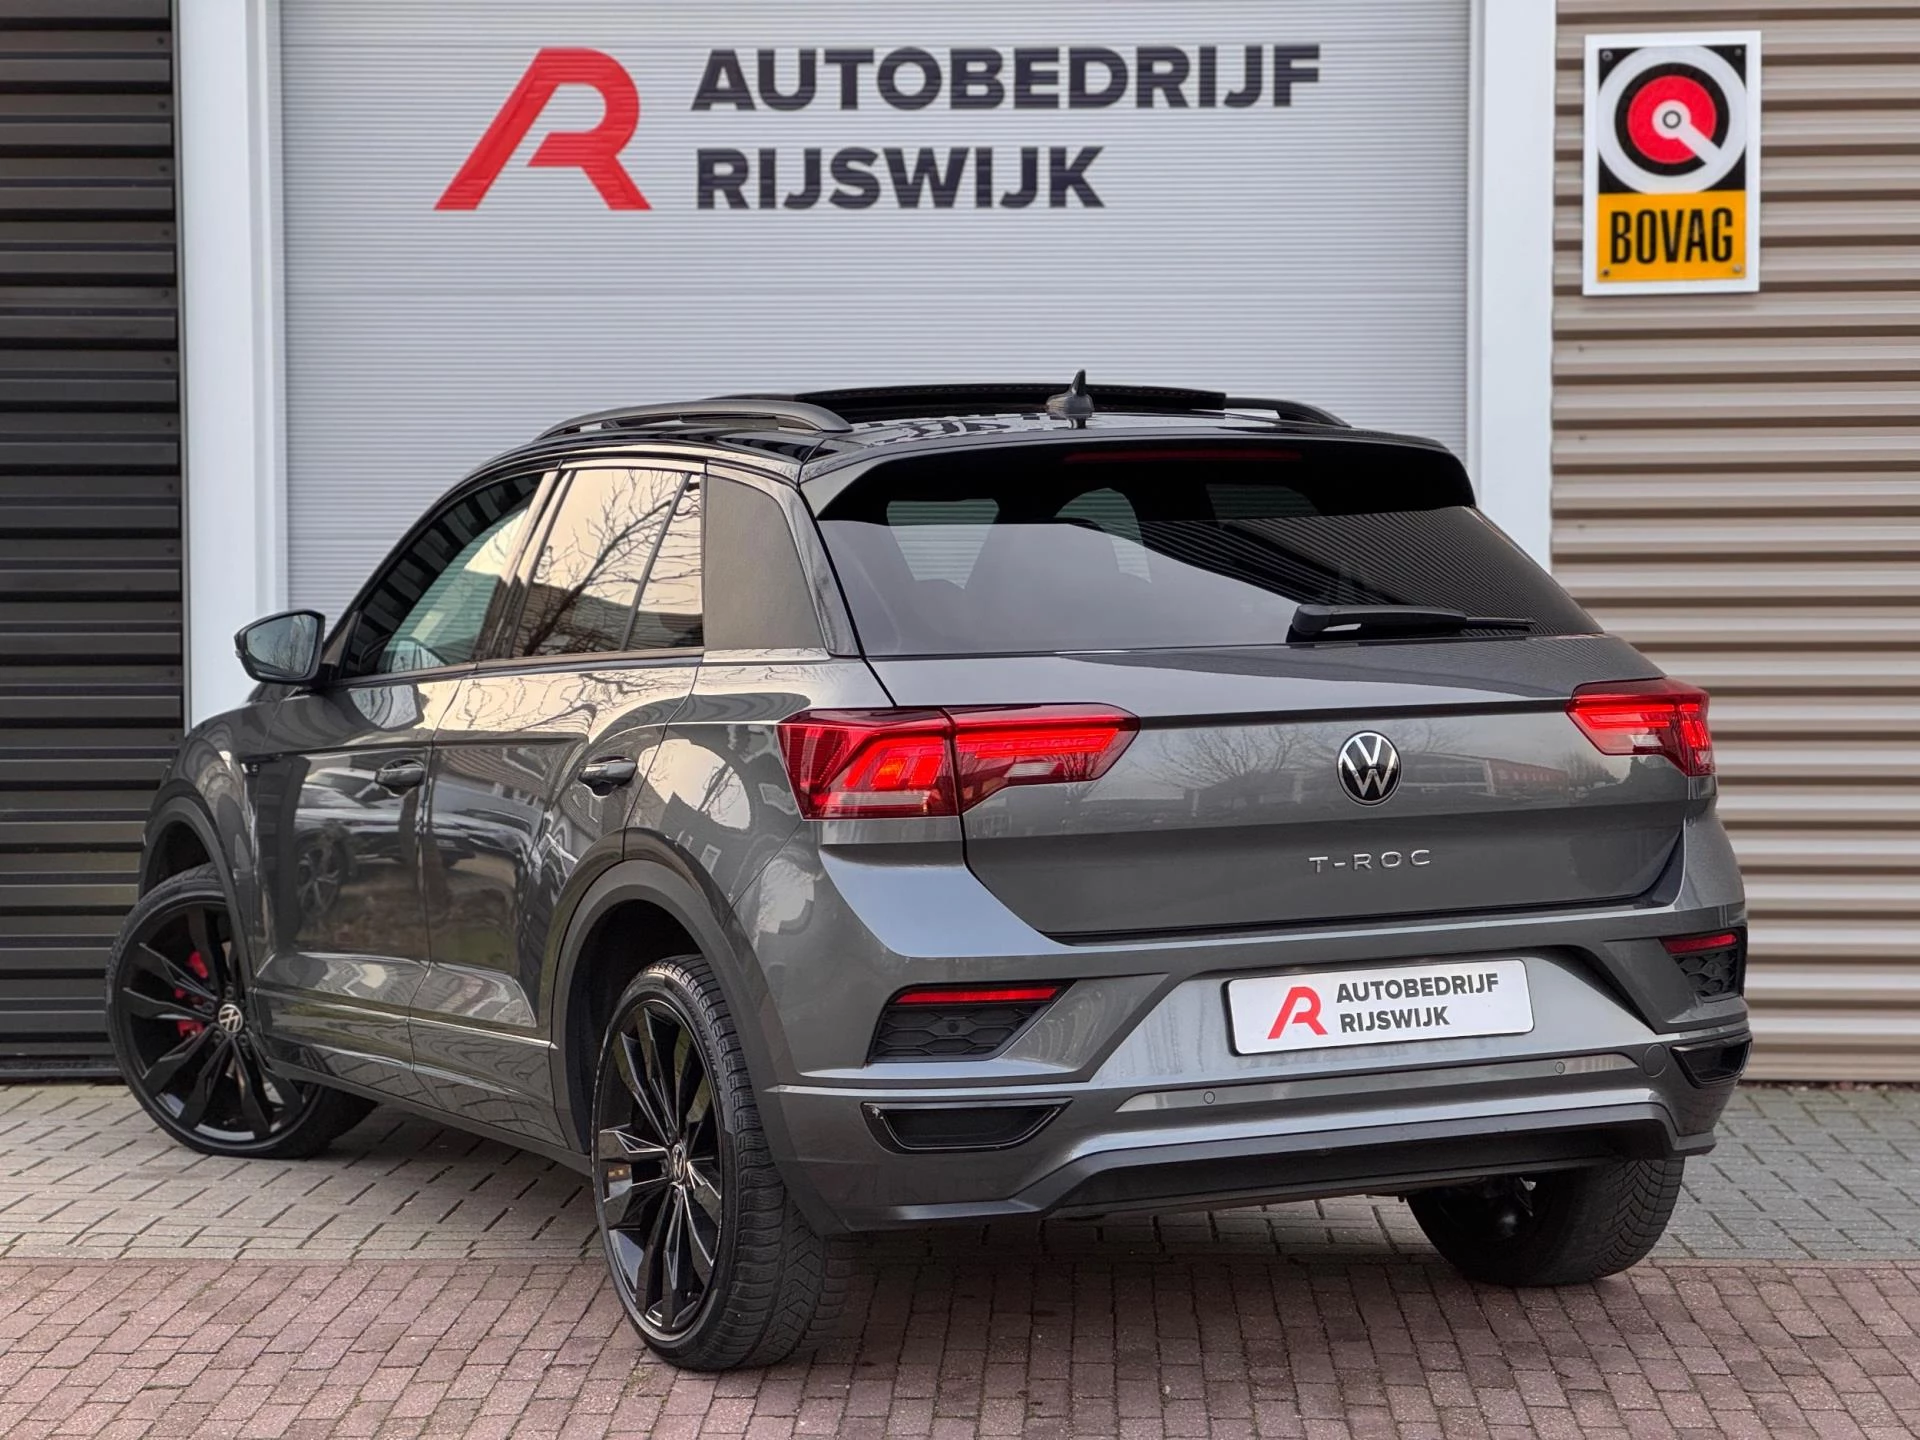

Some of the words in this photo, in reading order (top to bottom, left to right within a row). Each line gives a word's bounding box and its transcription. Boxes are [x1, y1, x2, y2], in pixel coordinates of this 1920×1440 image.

[692, 45, 1320, 112] AUTOBEDRIJF
[697, 146, 1105, 209] RIJSWIJK
[1610, 207, 1733, 264] BOVAG
[1308, 850, 1432, 873] T-ROC
[1336, 973, 1499, 1004] AUTOBEDRIJF
[1340, 1007, 1450, 1033] RIJSWIJK
